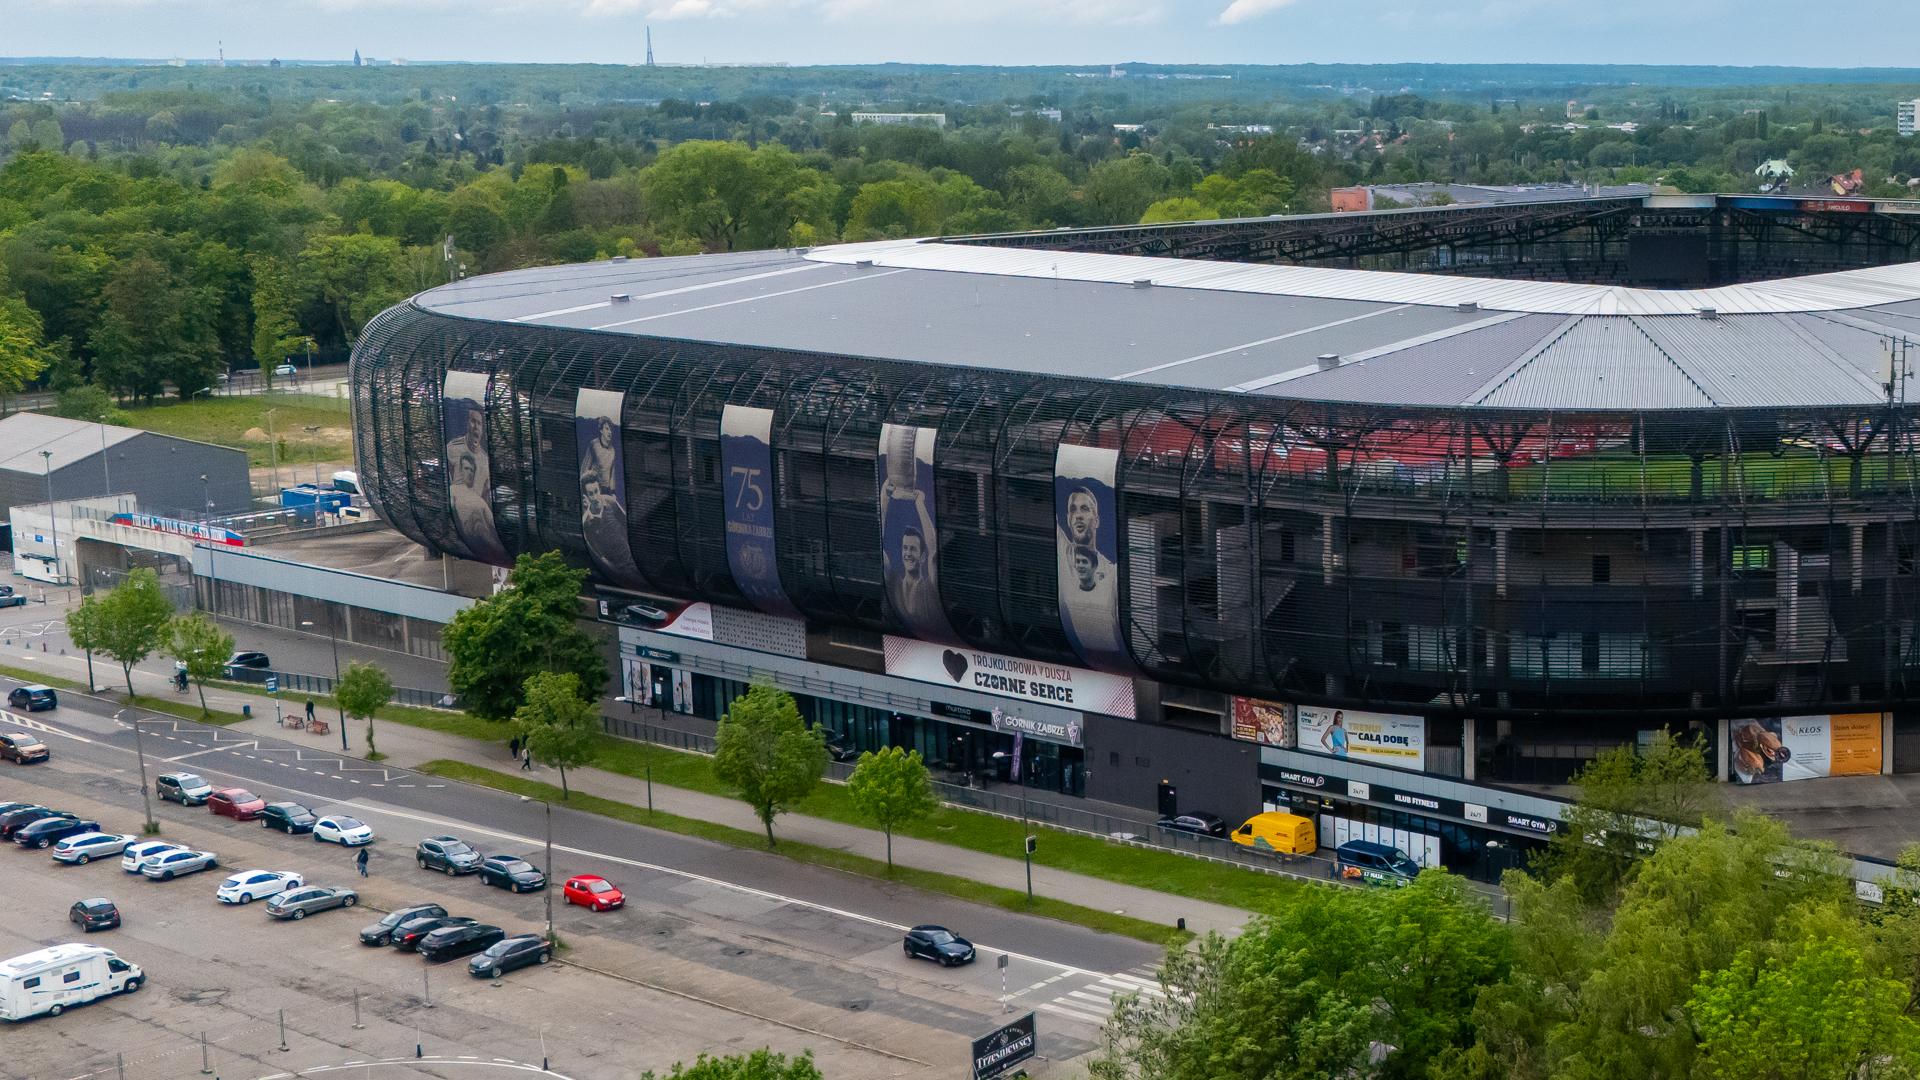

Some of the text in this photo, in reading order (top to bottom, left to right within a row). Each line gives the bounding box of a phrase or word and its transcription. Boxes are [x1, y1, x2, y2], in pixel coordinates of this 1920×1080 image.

[731, 466, 764, 511] 75
[1044, 667, 1072, 682] DUSZA
[974, 671, 1074, 703] CZORNE SERCE
[1005, 715, 1036, 731] GÓRNIK
[1036, 721, 1065, 737] ZABRZE
[1358, 733, 1382, 744] CAŁĄ
[1383, 736, 1409, 747] DOBĘ
[1280, 771, 1315, 785] SMART GYM
[1394, 794, 1439, 809] KLUB FITNESS
[1507, 815, 1546, 831] SMART GYM
